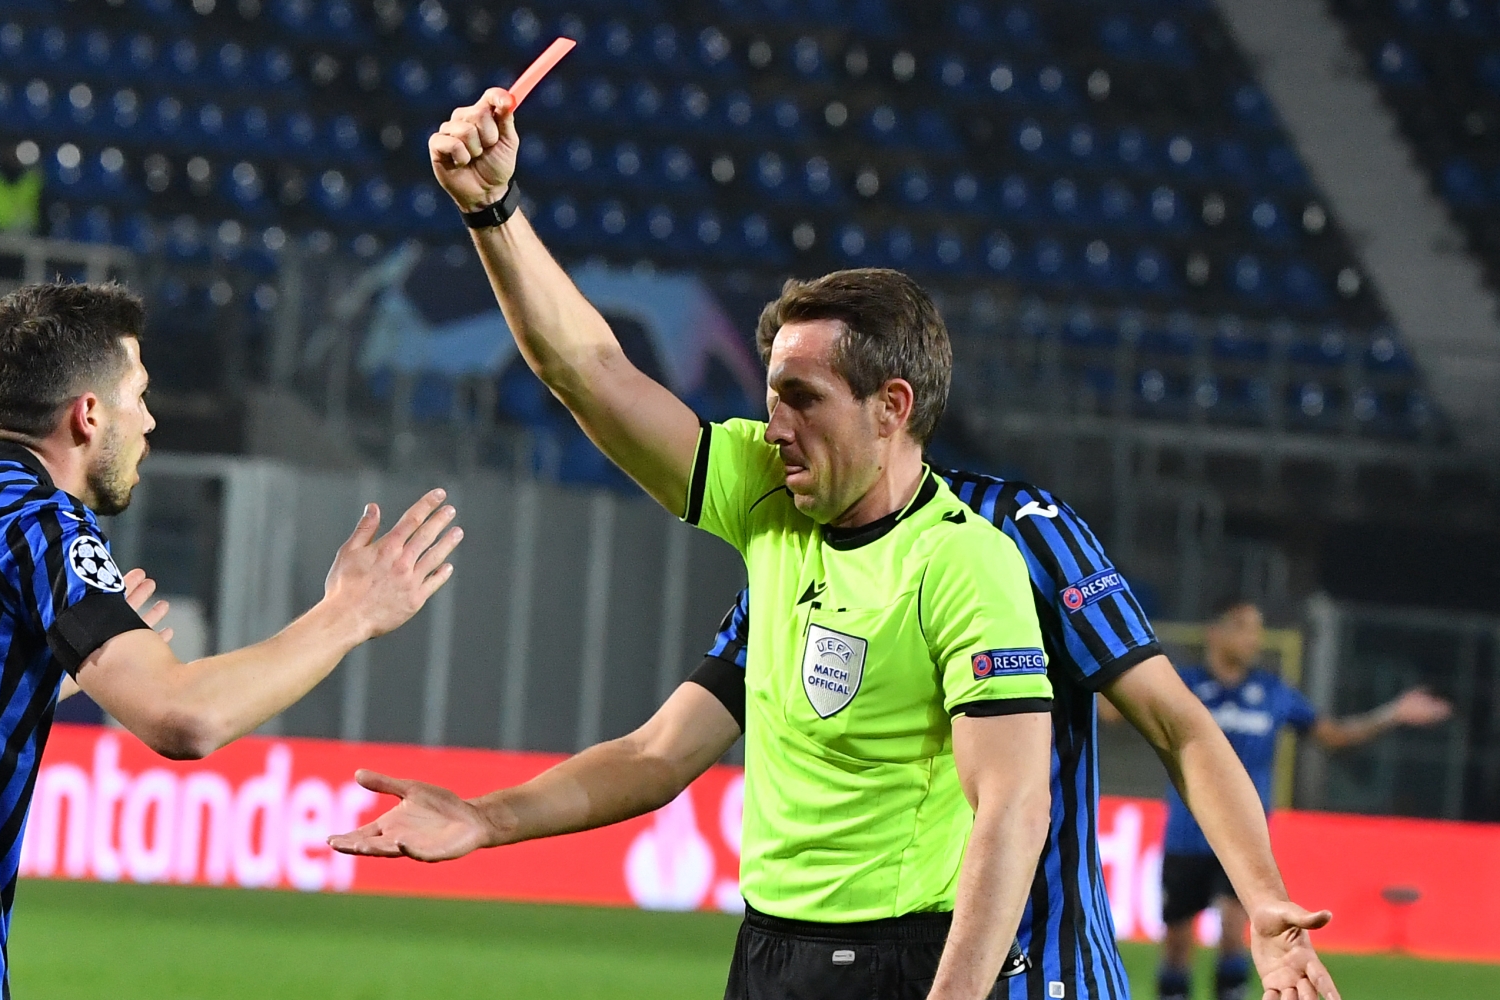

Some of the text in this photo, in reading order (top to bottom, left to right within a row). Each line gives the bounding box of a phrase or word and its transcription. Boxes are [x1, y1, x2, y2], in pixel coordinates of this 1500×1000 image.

[1081, 573, 1120, 599] RESPECT
[816, 640, 852, 661] UEFA
[813, 663, 848, 681] MATCH
[808, 675, 849, 695] OFFICIAL
